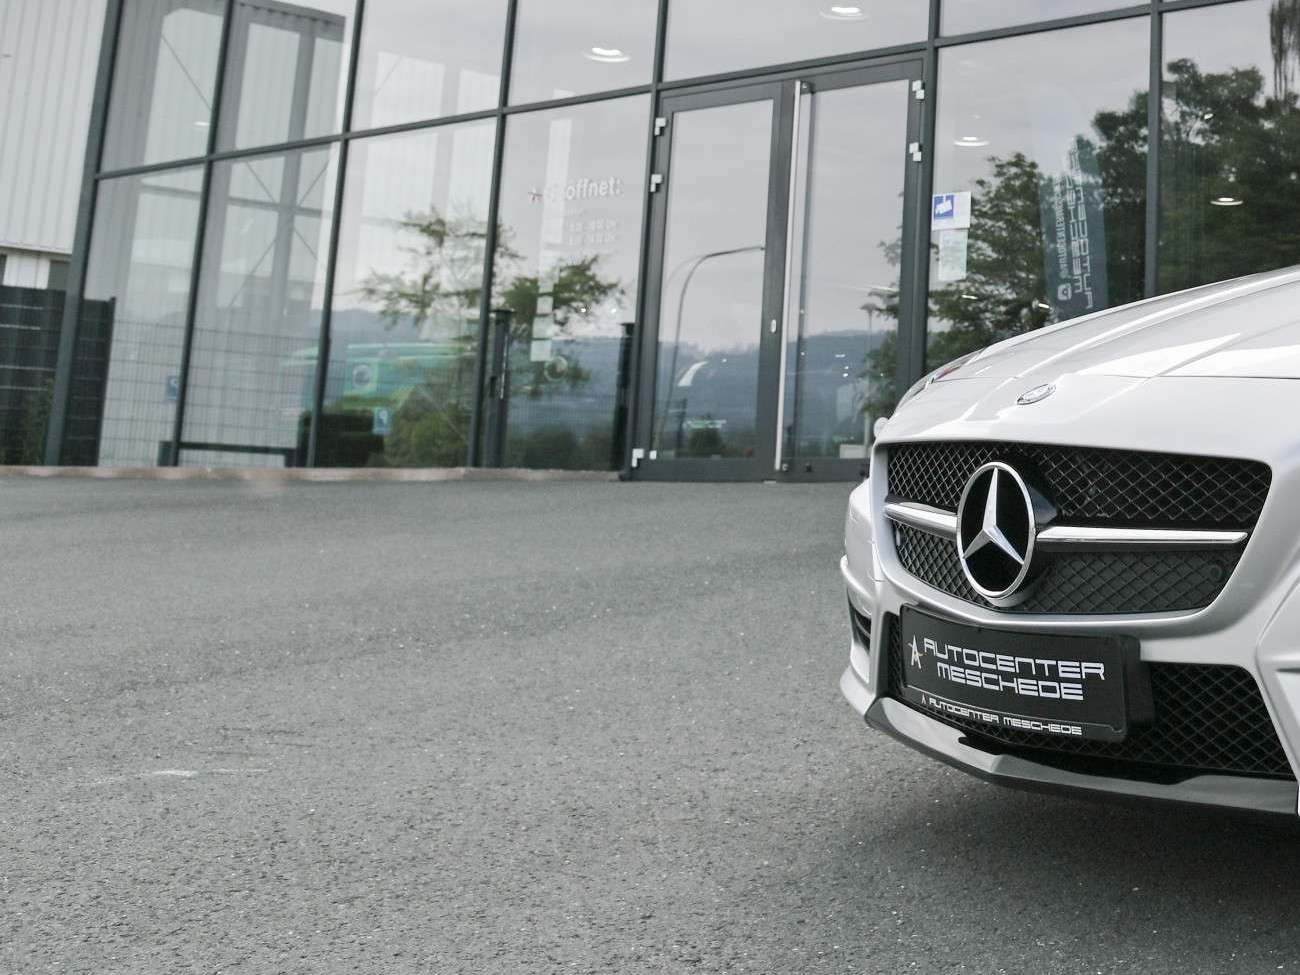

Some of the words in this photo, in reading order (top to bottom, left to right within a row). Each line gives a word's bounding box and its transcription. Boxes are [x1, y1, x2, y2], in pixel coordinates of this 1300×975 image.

[923, 637, 1106, 681] AUTOCENTER
[936, 661, 1084, 701] MESCHEDE
[928, 697, 1000, 725] AUTOCENTER
[1002, 716, 1083, 736] MESCHEDE
